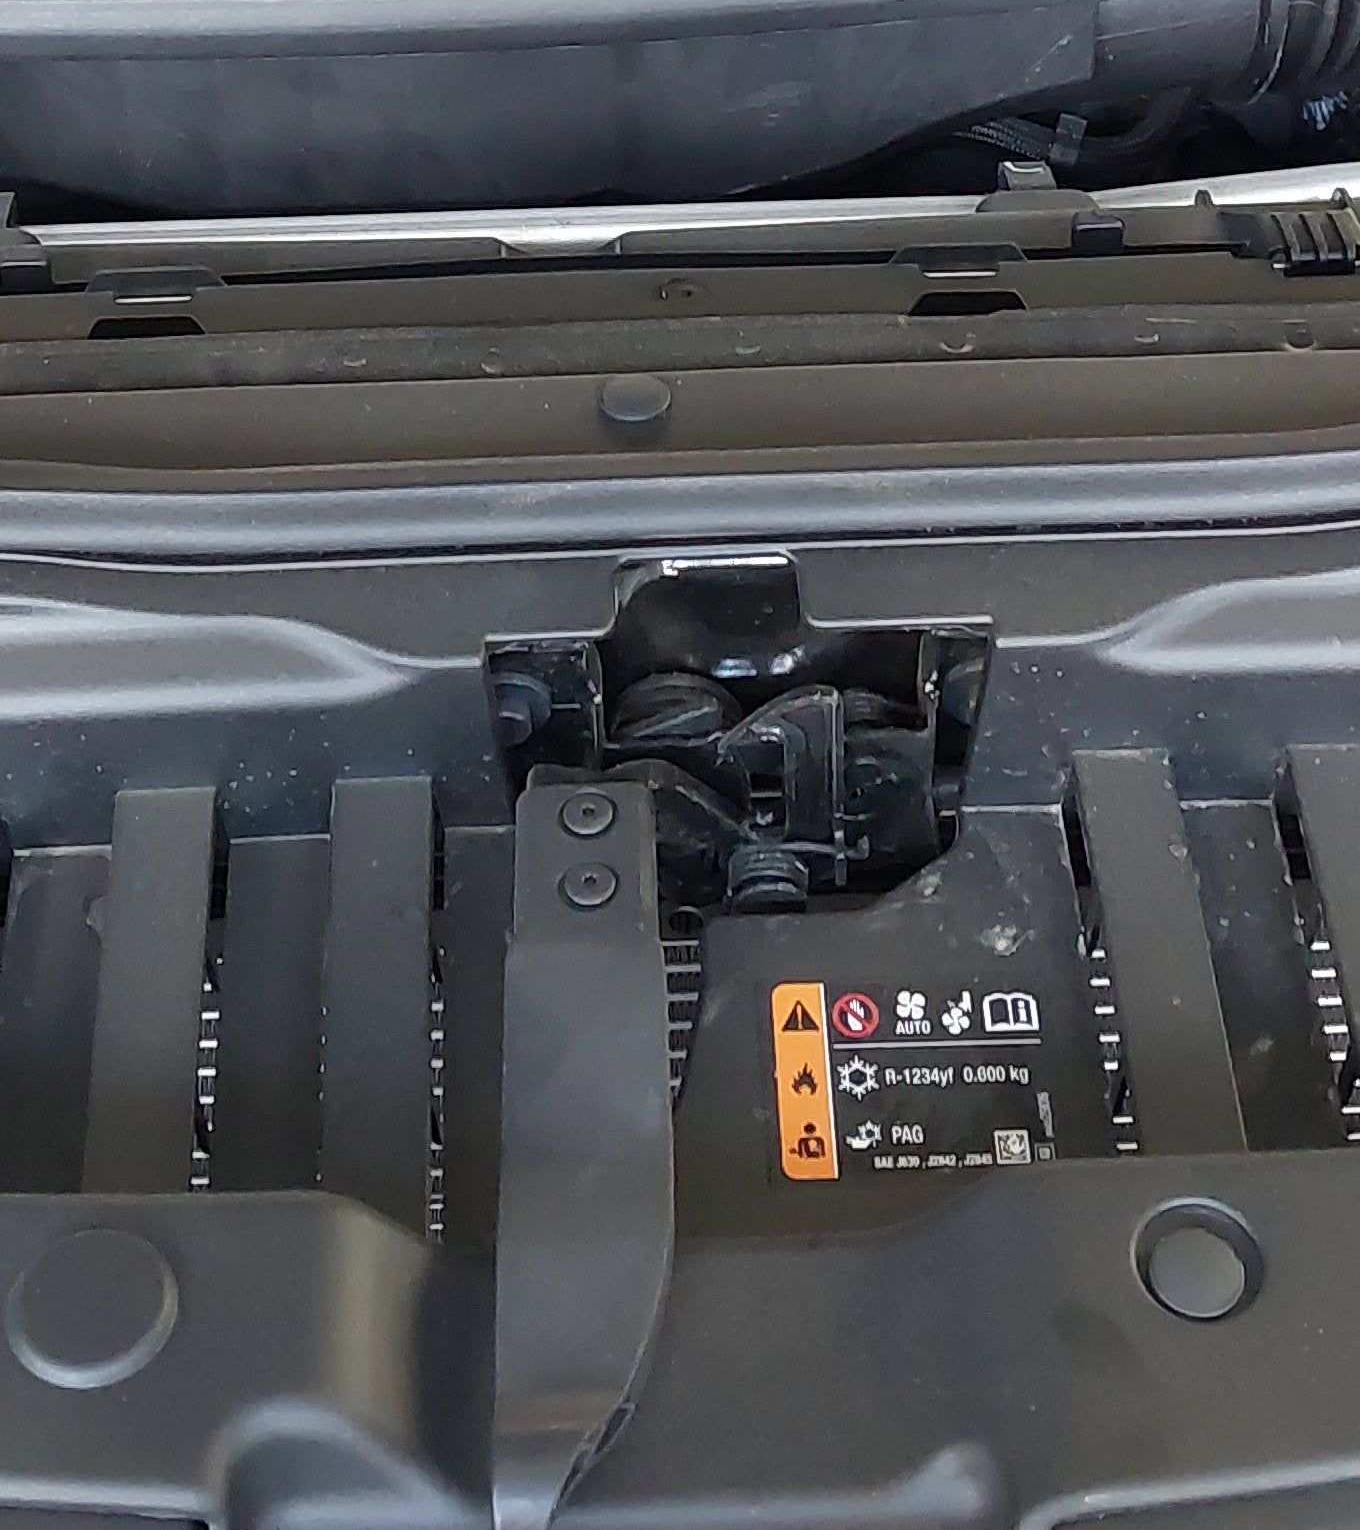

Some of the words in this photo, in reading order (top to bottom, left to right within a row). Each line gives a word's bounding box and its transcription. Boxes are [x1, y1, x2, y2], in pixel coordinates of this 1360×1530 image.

[895, 1020, 931, 1035] AUTO
[884, 1066, 954, 1088] R-1234yf
[1009, 1064, 1029, 1085] kg
[891, 1124, 924, 1145] PAG
